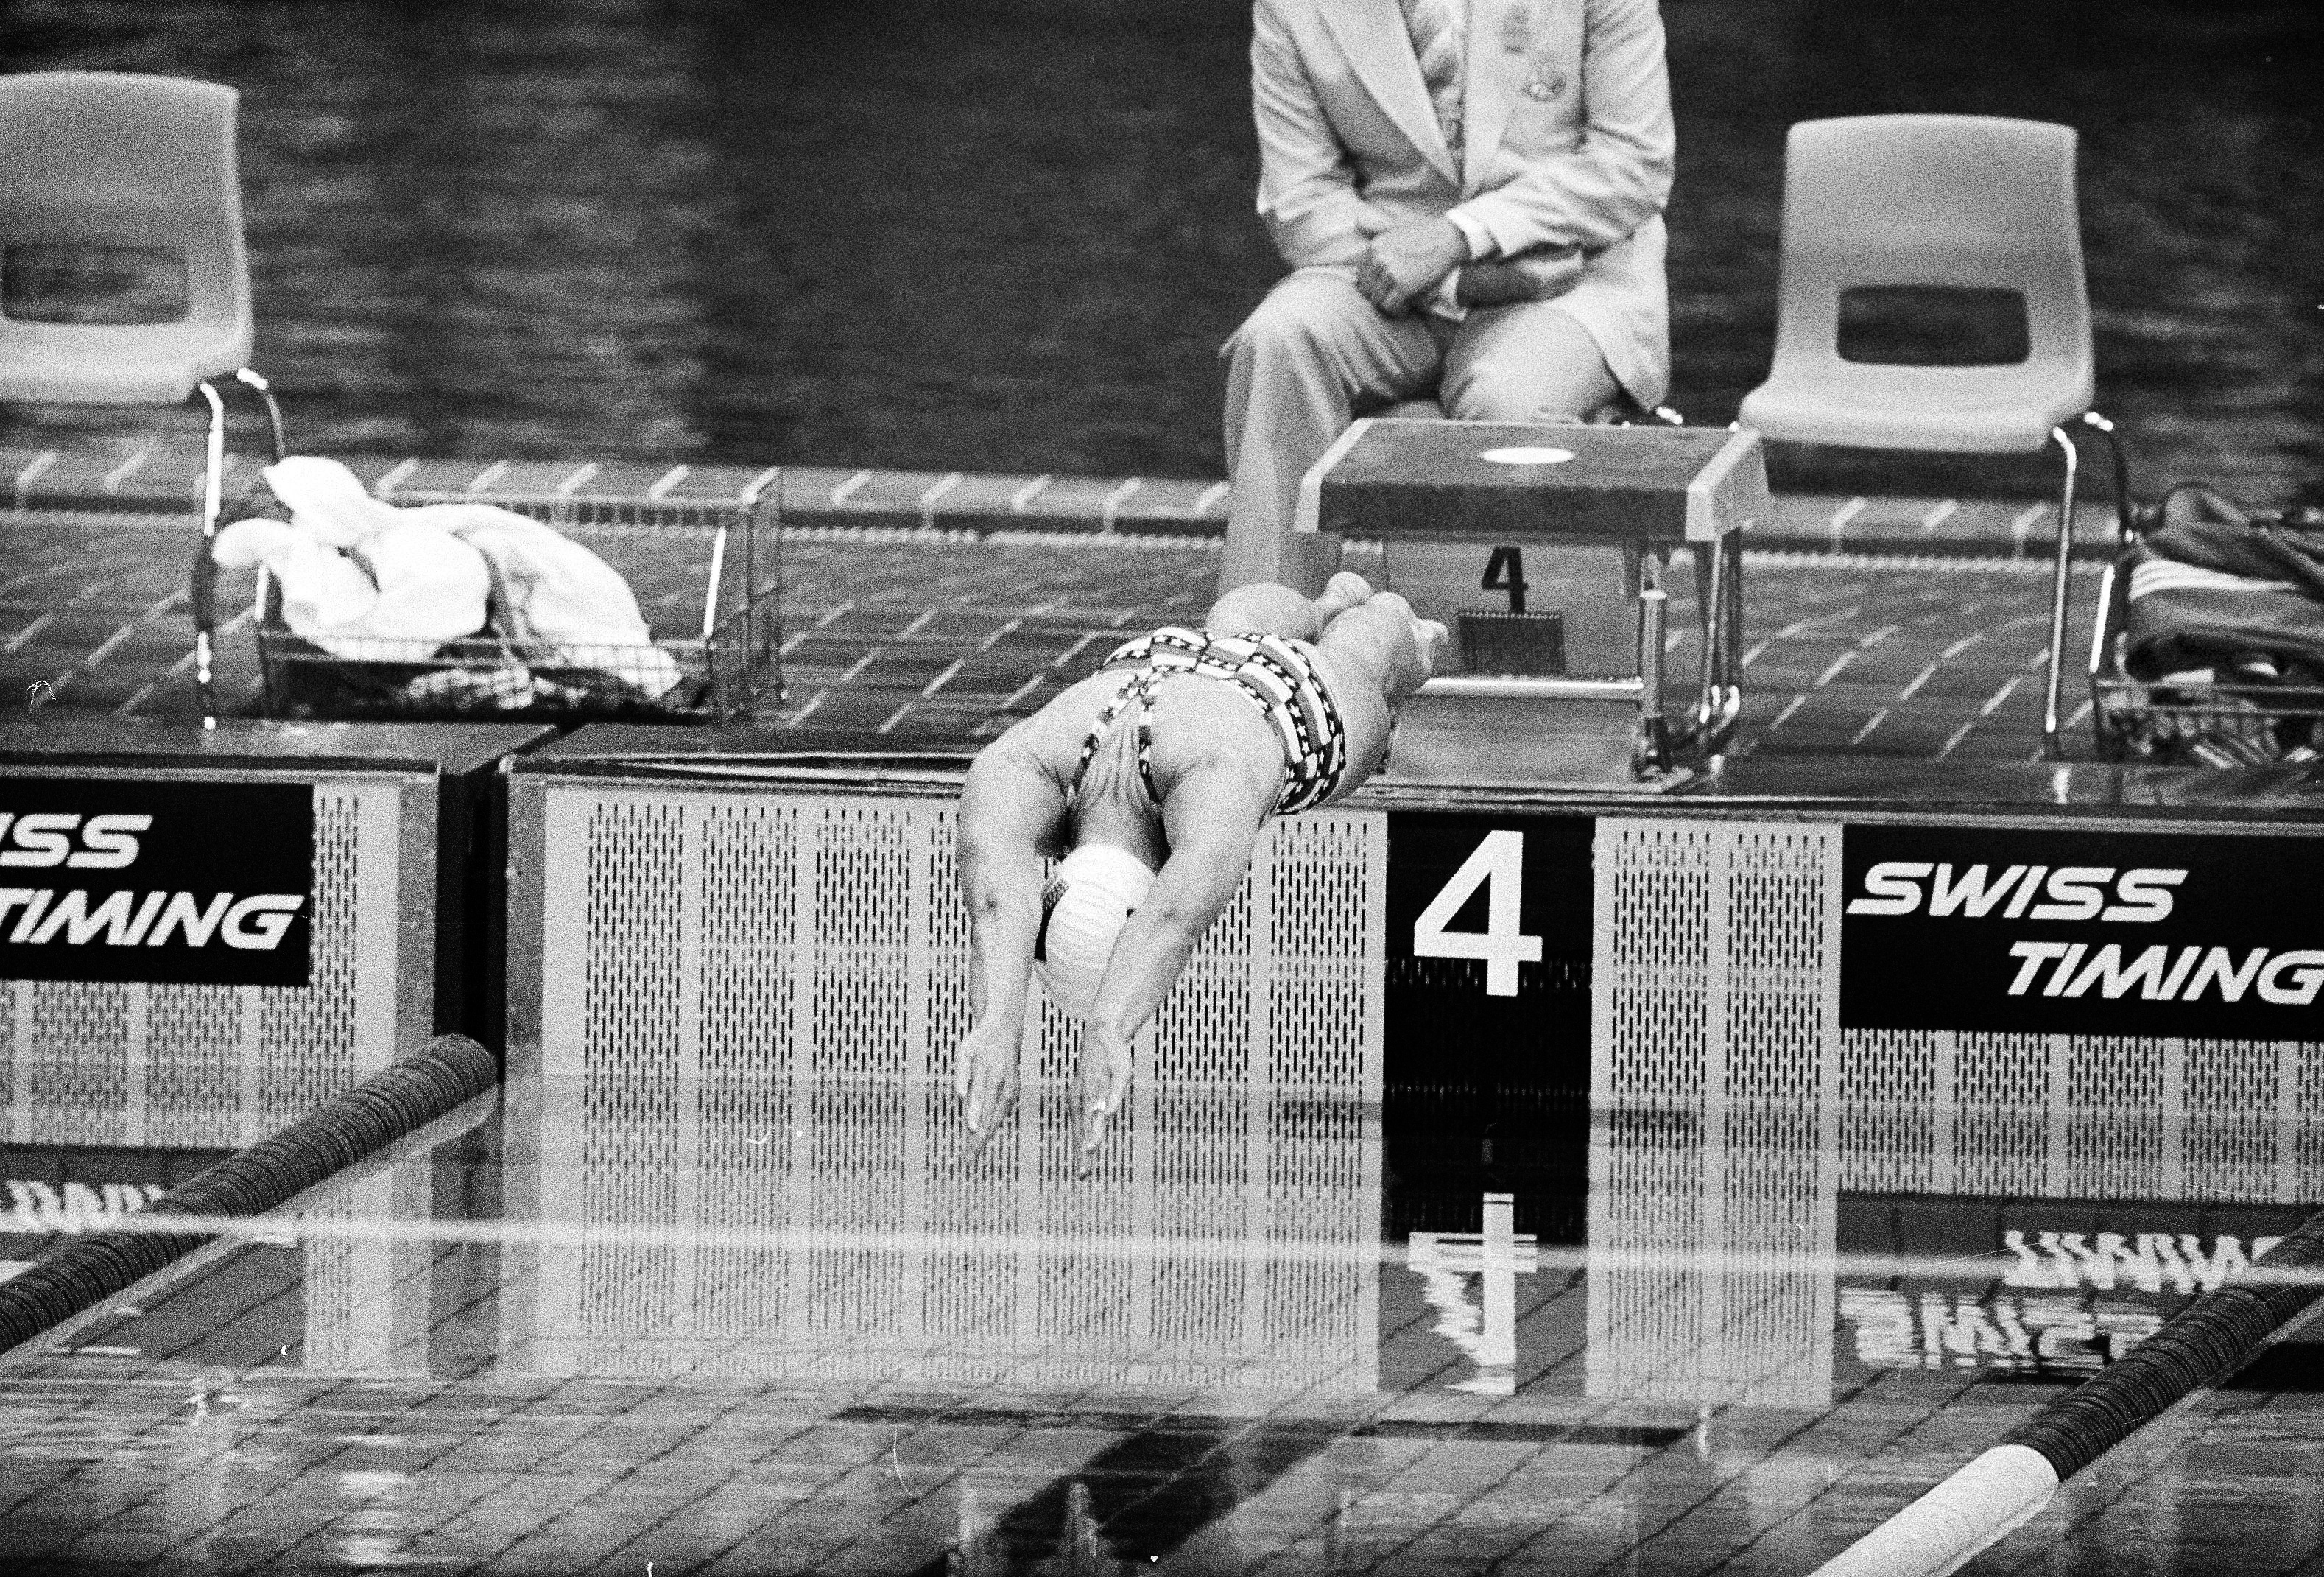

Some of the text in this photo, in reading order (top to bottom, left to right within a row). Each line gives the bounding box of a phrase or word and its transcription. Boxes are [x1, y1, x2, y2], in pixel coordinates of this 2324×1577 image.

[1481, 546, 1529, 615] 4
[0, 812, 153, 868] SS
[1414, 830, 1542, 997] 4
[1845, 861, 2189, 923] SWISS
[2007, 941, 2324, 1005] TIMING
